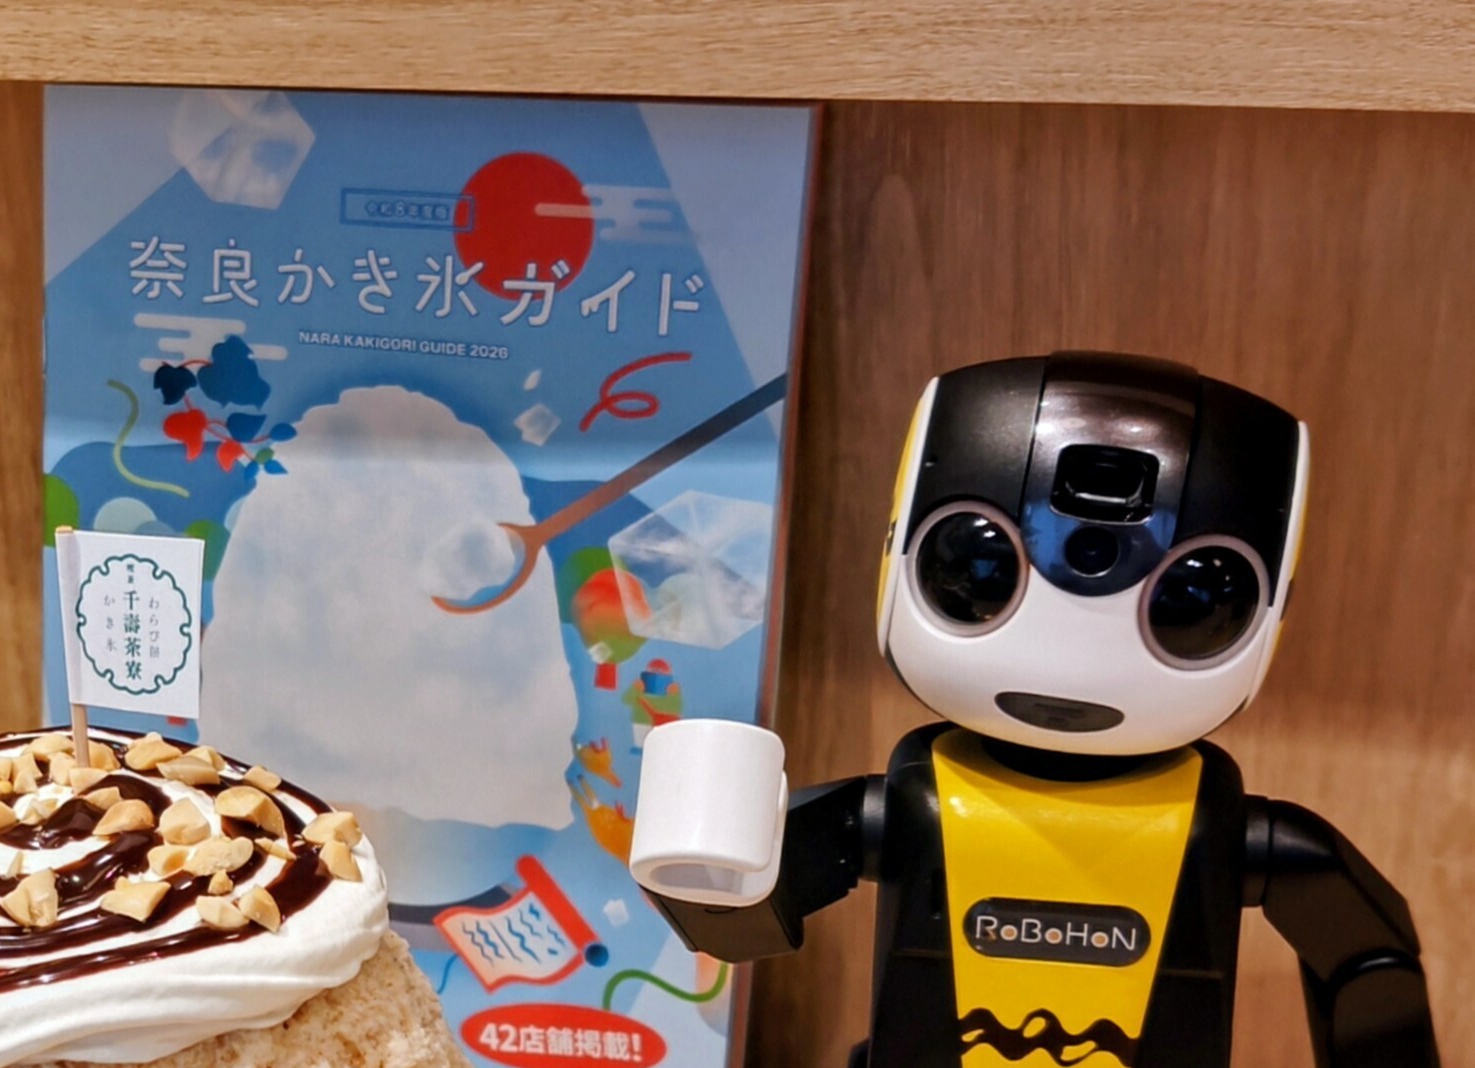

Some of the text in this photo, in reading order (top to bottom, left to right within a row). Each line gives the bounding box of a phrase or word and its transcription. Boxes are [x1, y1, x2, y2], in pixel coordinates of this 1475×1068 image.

[128, 235, 705, 337] 奈良かき氷ガイド
[299, 331, 509, 360] NARA KAKIGORI GUIDE 2026
[478, 1022, 643, 1063] 42店舗掲載!
